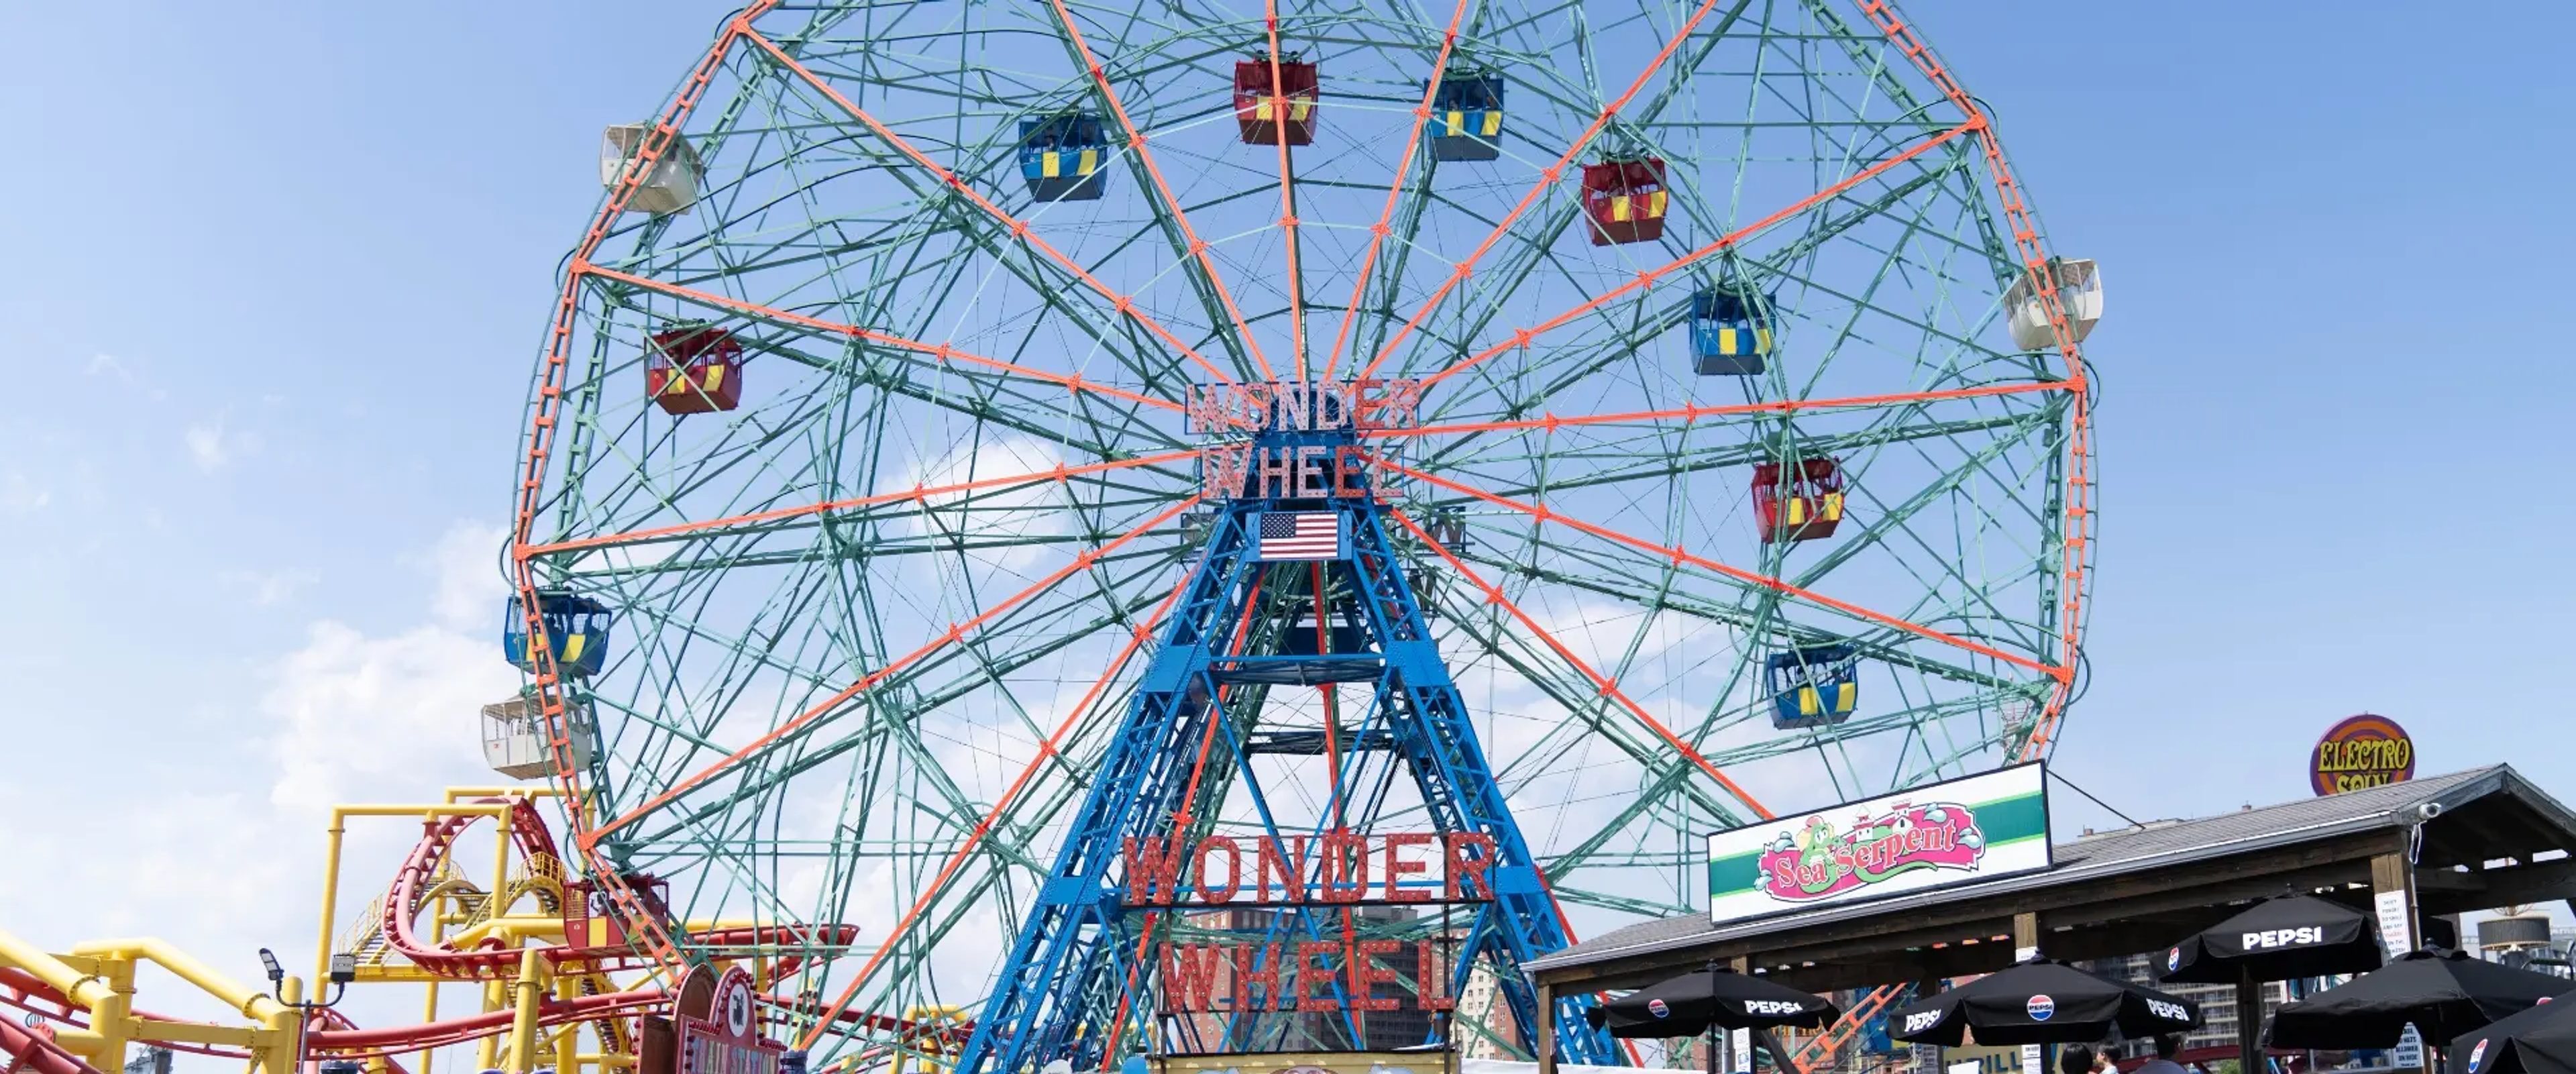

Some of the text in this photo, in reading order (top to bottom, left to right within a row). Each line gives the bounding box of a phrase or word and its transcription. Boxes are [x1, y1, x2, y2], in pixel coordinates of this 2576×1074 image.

[1186, 378, 1420, 433] WONDER
[1201, 445, 1404, 498] WHEEL
[2318, 739, 2411, 771] ELECTRO
[1122, 832, 1496, 906] WONDER
[1774, 818, 1957, 888] Sea Serpent
[2242, 926, 2322, 951] PEPSI
[1159, 939, 1455, 1014] WHEEL
[1744, 1000, 1803, 1014] PEPSI
[1904, 1008, 1942, 1032] PEPSI
[2145, 998, 2190, 1021] PEPSI
